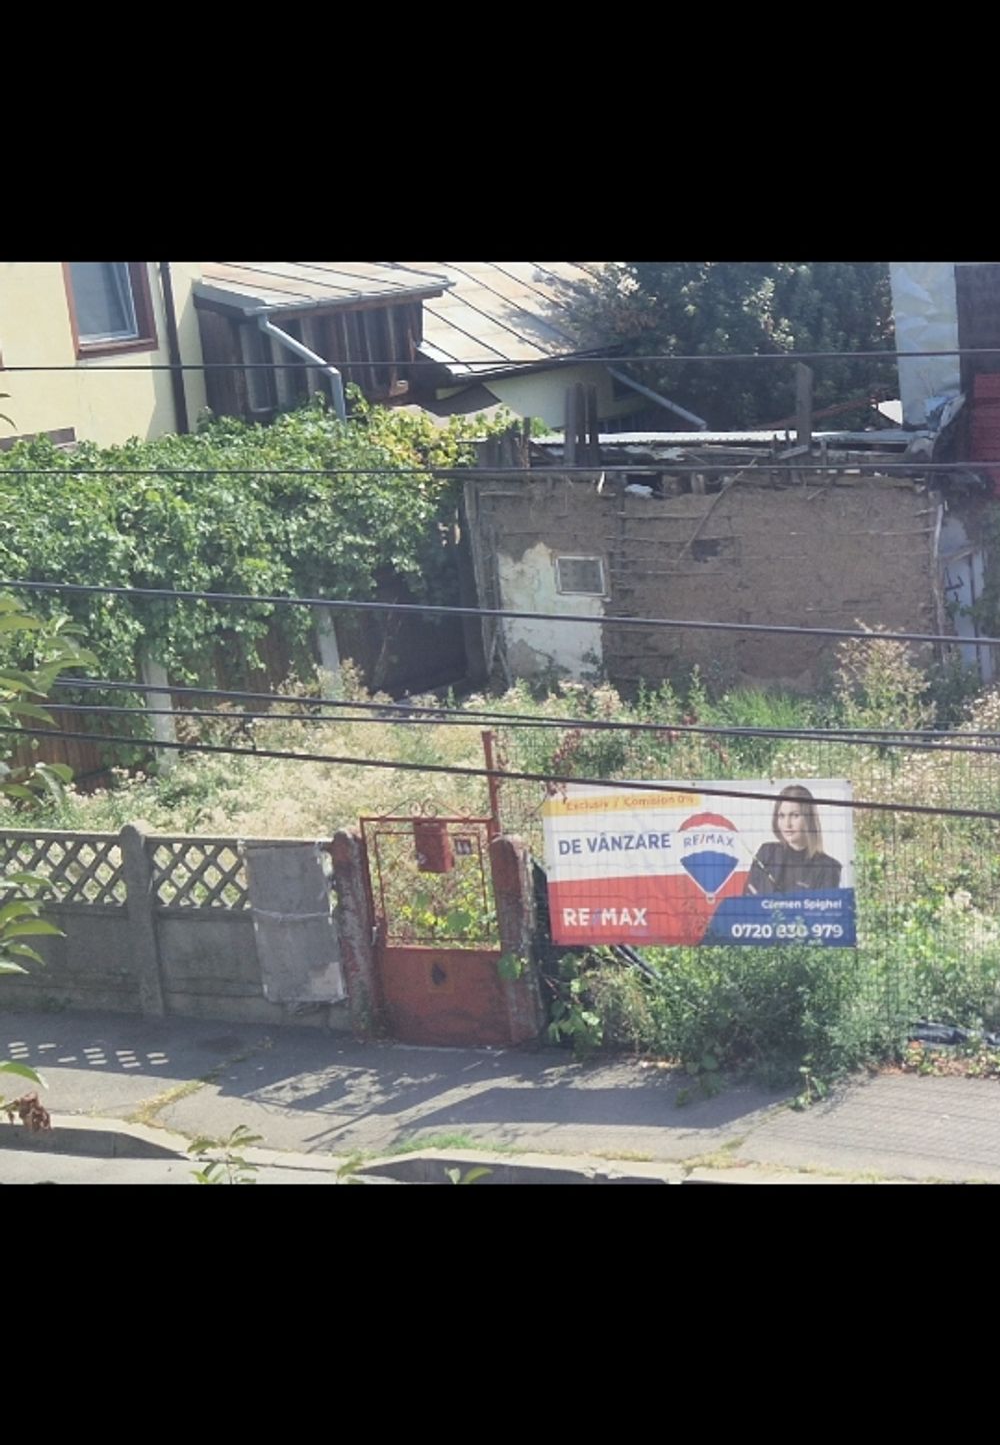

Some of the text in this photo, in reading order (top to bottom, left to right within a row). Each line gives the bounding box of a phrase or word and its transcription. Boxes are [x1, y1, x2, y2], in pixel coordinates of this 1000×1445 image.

[565, 800, 609, 811] Exclusiv
[623, 795, 676, 807] Comision
[558, 832, 672, 855] DE VÂNZARE
[683, 833, 735, 848] RE/MAX
[731, 924, 772, 938] 0720
[811, 924, 844, 938] 979
